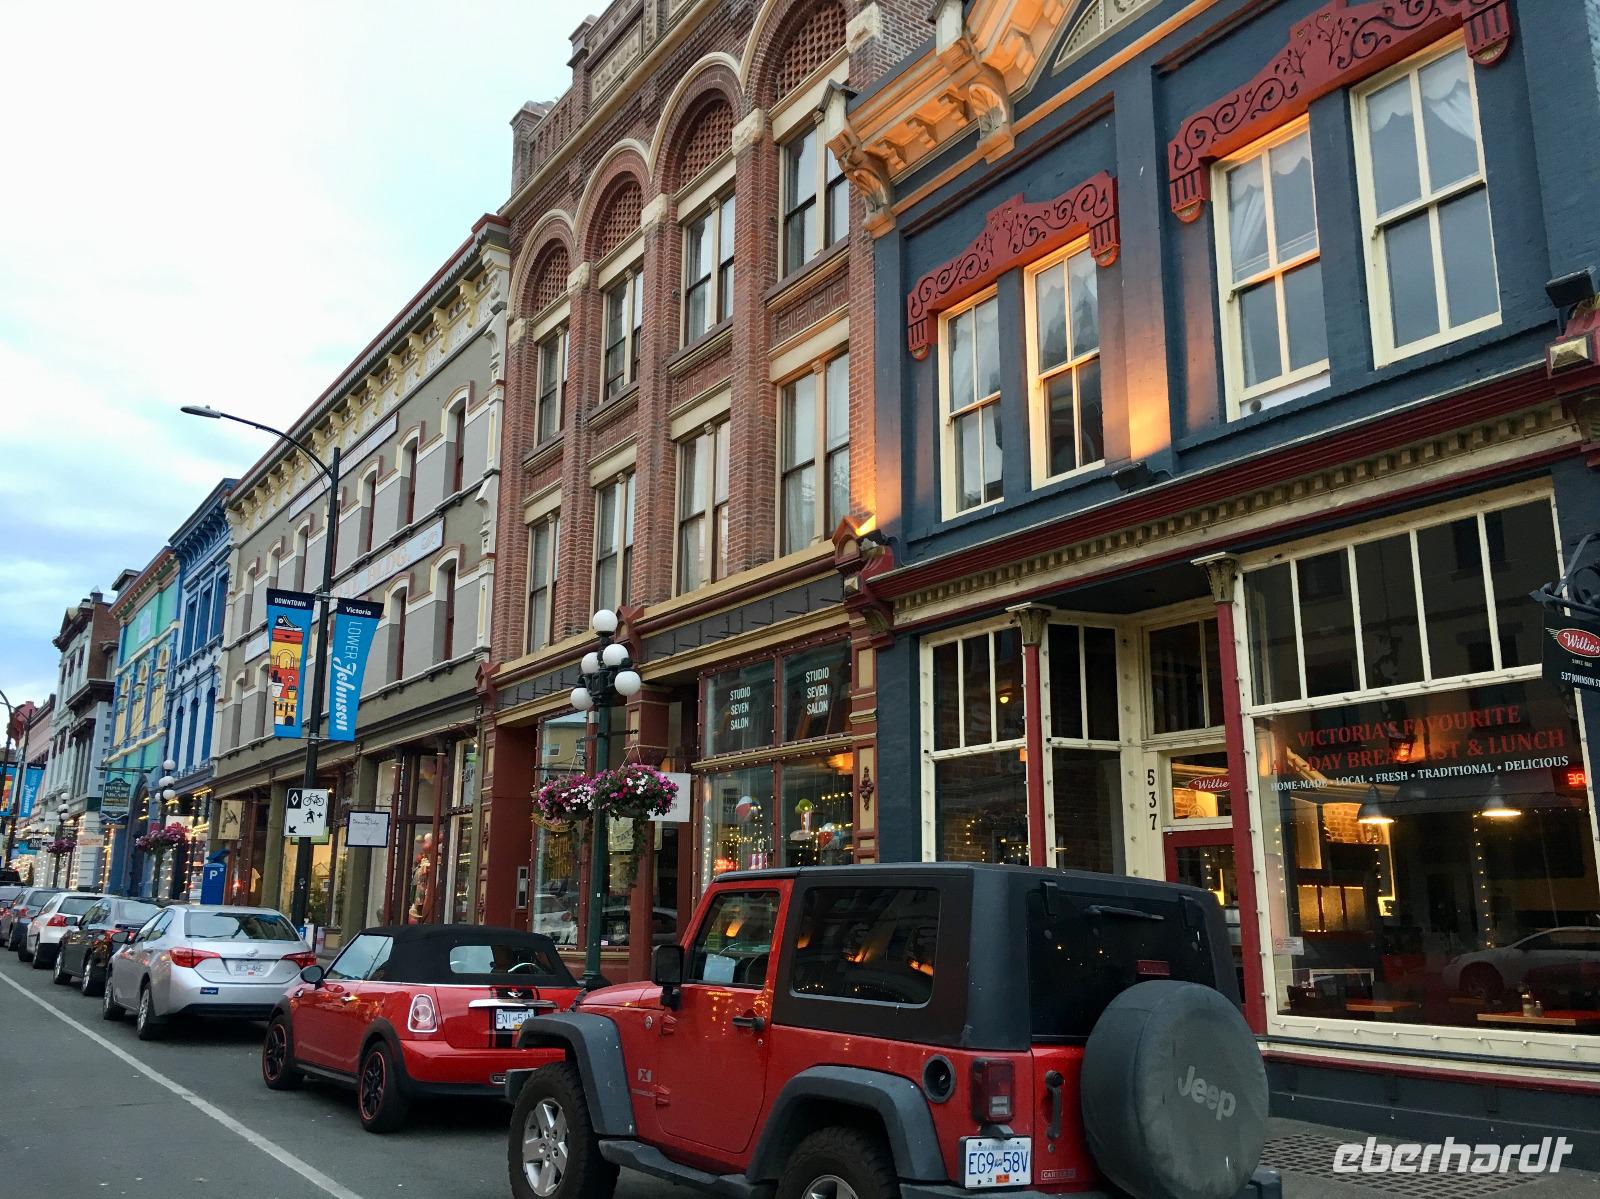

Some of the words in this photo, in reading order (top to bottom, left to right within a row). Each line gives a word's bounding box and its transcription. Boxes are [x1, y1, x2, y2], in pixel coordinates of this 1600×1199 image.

[274, 597, 307, 607] DOWNTOWN
[346, 606, 372, 616] Victoria
[343, 621, 363, 660] LOWER
[1563, 632, 1600, 654] Willie's
[805, 667, 829, 683] STUDIO
[1561, 671, 1571, 680] 537
[1571, 673, 1594, 687] JOHNSON
[332, 656, 358, 731] Johnson
[730, 686, 751, 701] STUDIO
[807, 684, 828, 699] SEVEN
[730, 702, 749, 716] SEVEN
[807, 700, 828, 715] SALON
[730, 717, 749, 731] SALON
[1298, 720, 1399, 747] VICTORIA'S
[1403, 705, 1521, 735] FAVOURITE
[1467, 739, 1483, 756] &
[1489, 728, 1565, 753] LUNCH
[1271, 779, 1328, 791] HOME-MADE
[1336, 774, 1367, 786] LOCAL
[1375, 771, 1408, 783] FRESH
[1418, 763, 1495, 779] TRADITIONAL
[1505, 756, 1569, 772] DELICIOUS
[209, 870, 218, 880] P
[1178, 1065, 1236, 1120] Jeep
[968, 1152, 995, 1175] EG9
[1003, 1151, 1028, 1173] 58V
